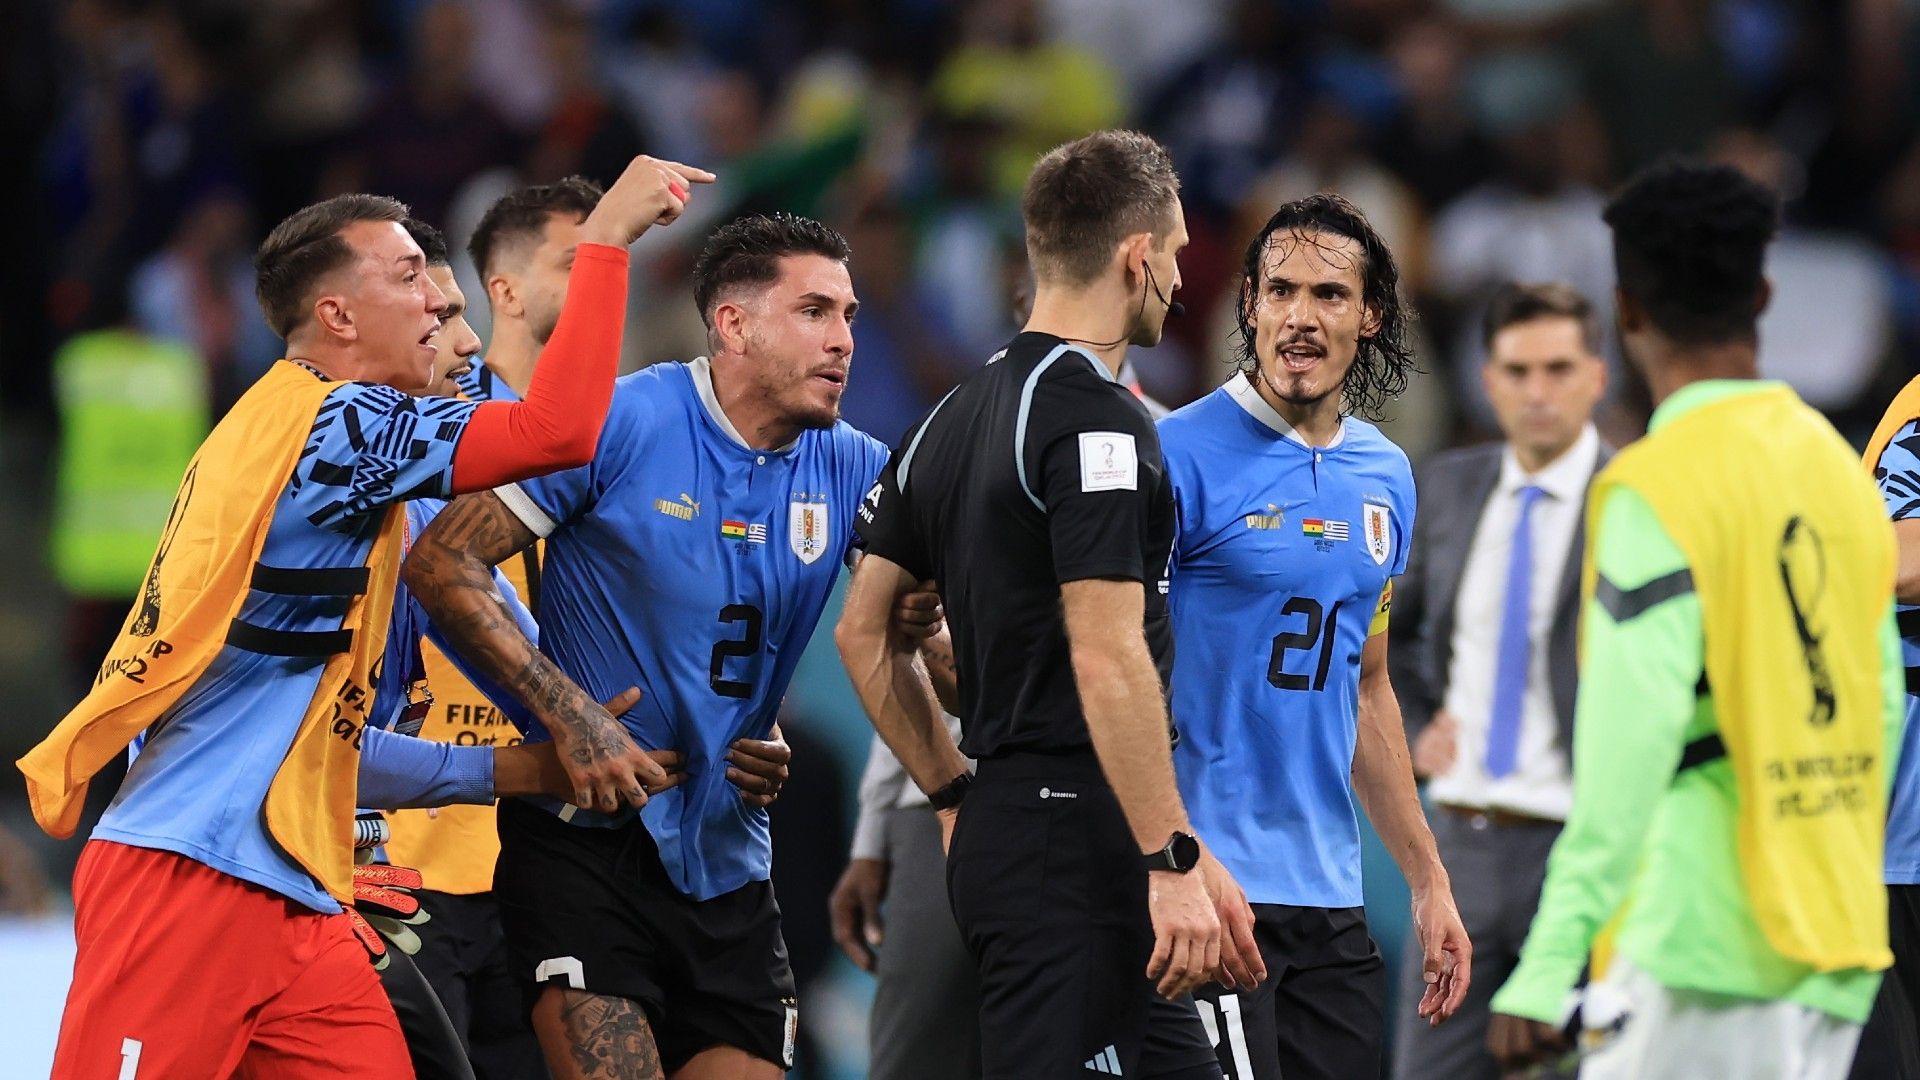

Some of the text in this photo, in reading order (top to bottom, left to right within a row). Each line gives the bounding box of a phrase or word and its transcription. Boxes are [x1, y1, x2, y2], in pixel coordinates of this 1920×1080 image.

[654, 498, 693, 521] PUMA
[709, 603, 762, 699] 2
[1266, 596, 1343, 692] 21
[446, 704, 497, 727] FIFA
